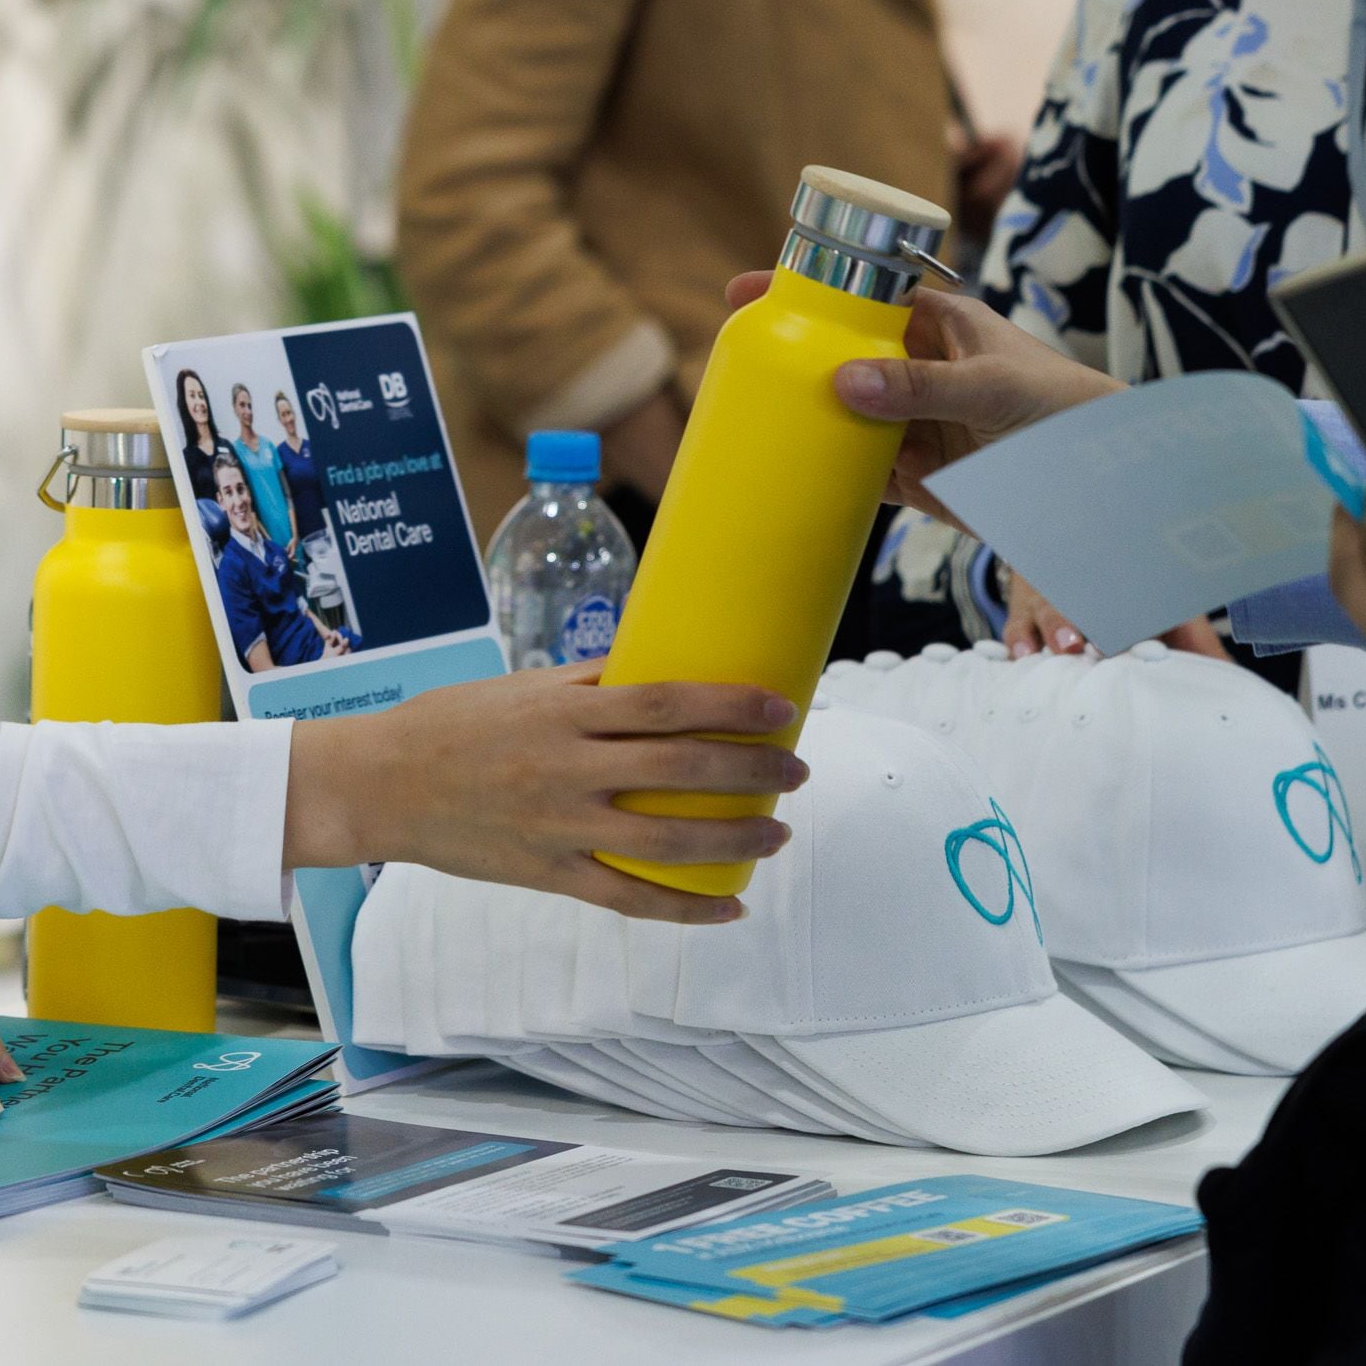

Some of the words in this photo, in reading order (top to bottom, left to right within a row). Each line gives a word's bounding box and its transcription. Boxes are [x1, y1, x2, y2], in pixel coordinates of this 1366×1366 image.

[377, 371, 408, 401] DB
[326, 463, 356, 486] Find
[383, 461, 405, 482] you
[336, 490, 401, 525] National
[344, 524, 396, 556] Dental
[395, 521, 434, 548] Care
[308, 701, 332, 720] your
[331, 693, 373, 714] interest
[1317, 693, 1346, 710] Ms
[30, 1037, 92, 1062] You
[74, 1041, 136, 1066] The
[2, 1067, 88, 1109] Partne
[781, 1188, 948, 1229] COFFEE
